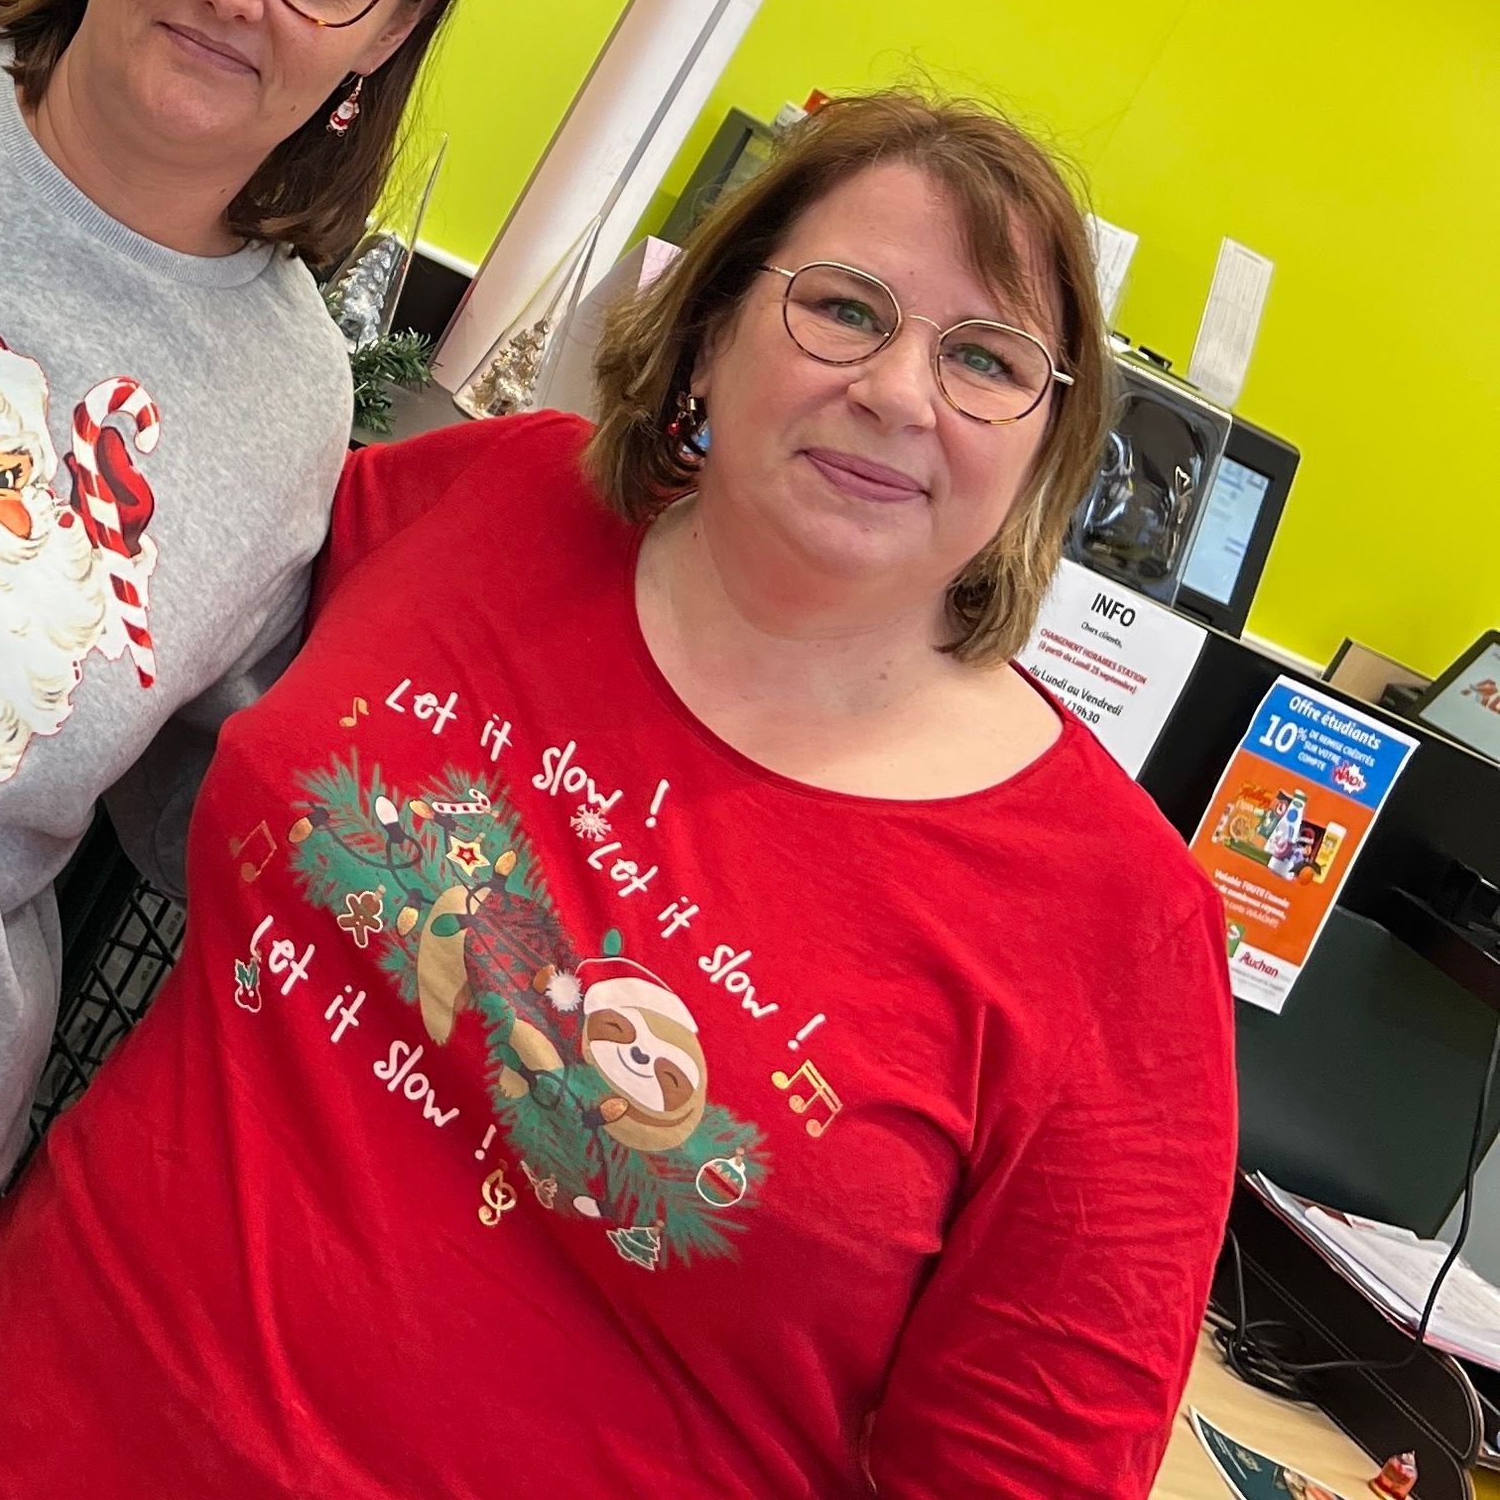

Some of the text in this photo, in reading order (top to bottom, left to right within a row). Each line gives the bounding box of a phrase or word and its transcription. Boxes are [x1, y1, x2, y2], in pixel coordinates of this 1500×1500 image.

[1091, 593, 1136, 627] INFO
[1040, 628, 1146, 683] CHANGEMENT HORAIRES STATION
[1045, 645, 1062, 657] partir
[1063, 653, 1071, 661] du
[1072, 657, 1090, 670] Lundi
[1098, 670, 1136, 694] septembre)
[1029, 664, 1041, 675] du
[1041, 669, 1067, 688] Lundi
[1067, 685, 1078, 694] au
[1080, 687, 1123, 715] Vendredi
[1072, 703, 1100, 724] 19h30
[385, 678, 458, 735] Let
[481, 713, 512, 762] it
[1288, 694, 1382, 750] Offre étudiants
[1318, 733, 1343, 751] REMISE
[1297, 751, 1326, 770] COMPTE
[1303, 741, 1340, 763] SUR VOTRE
[587, 841, 658, 897] Let
[657, 895, 700, 938] it
[250, 915, 315, 995] Let
[324, 985, 366, 1043] it
[1239, 951, 1278, 978] Auchan
